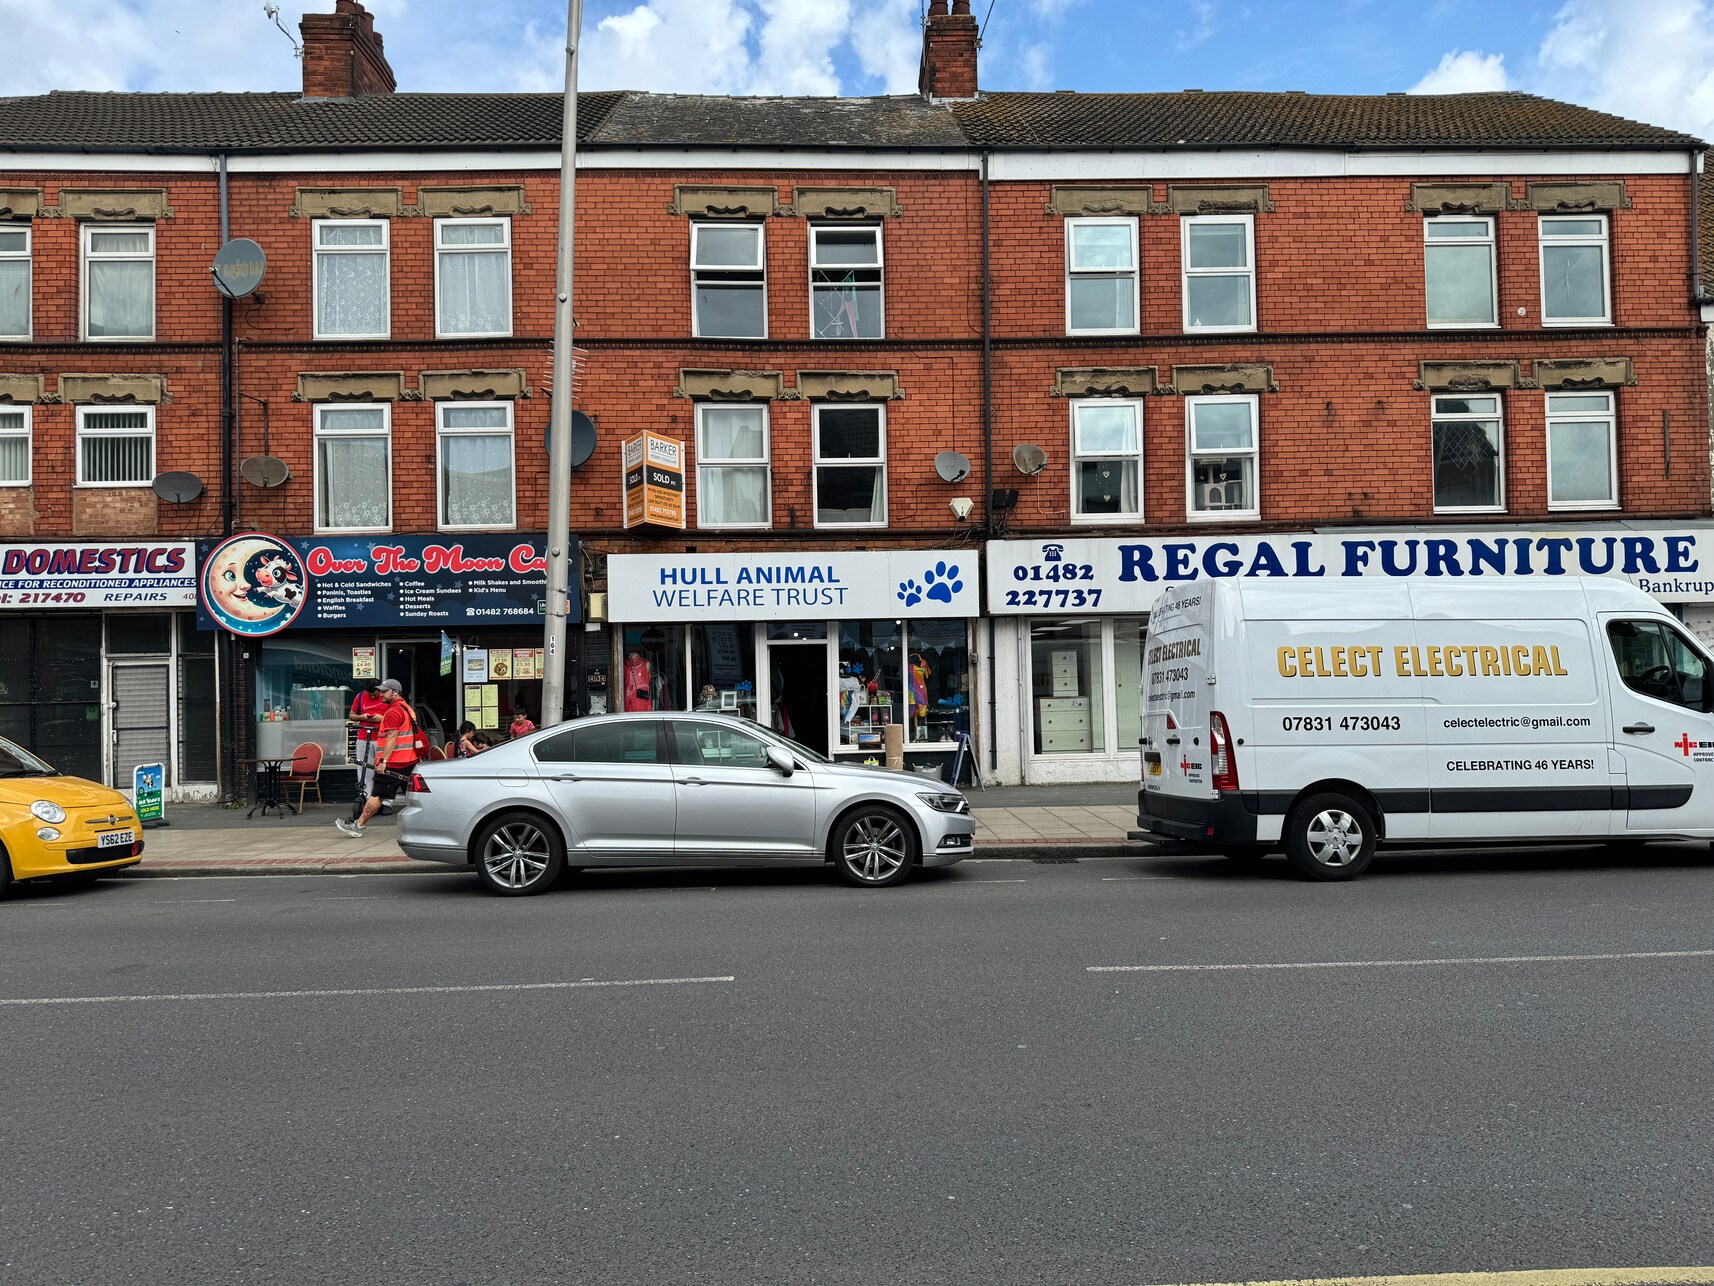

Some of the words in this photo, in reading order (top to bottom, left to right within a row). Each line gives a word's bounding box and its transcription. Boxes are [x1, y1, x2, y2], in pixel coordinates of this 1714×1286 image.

[650, 439, 677, 457] BARKER
[653, 472, 670, 484] SOLD
[2, 547, 186, 575] DOMESTICS
[307, 546, 367, 576] Over
[371, 545, 420, 575] The
[422, 544, 505, 573] Moon
[508, 544, 550, 576] Ca
[1118, 541, 1326, 582] REGAL
[1340, 535, 1700, 577] FURNITURE
[660, 567, 728, 585] HULL
[736, 565, 841, 584] ANIMAL
[1013, 563, 1095, 583] 01482
[18, 580, 40, 589] FOR
[43, 578, 129, 588] RECONDITIONED
[132, 578, 197, 587] APPLIANCES
[0, 592, 13, 604] l:
[18, 592, 86, 604] 217470
[104, 592, 168, 602] REPAIRS
[322, 597, 345, 605] English
[653, 588, 765, 607] WELFARE
[771, 587, 849, 606] TRUST
[1005, 588, 1102, 608] 227737
[1174, 600, 1181, 610] 46
[1181, 596, 1202, 609] YEARS!
[475, 608, 501, 616] 01482
[503, 607, 534, 615] 768684
[1162, 638, 1202, 662] ELECTRICAL
[1276, 646, 1383, 678] CELECT
[1393, 645, 1568, 678] ELECTRICAL
[1165, 667, 1189, 683] 473043
[1282, 716, 1332, 731] 07831
[1340, 715, 1401, 731] 473043
[1443, 716, 1591, 729] celectelectric@gmail.com
[1446, 759, 1532, 771] CELEBRATING
[1535, 759, 1548, 770] 46
[1551, 758, 1594, 770] YEARS!
[100, 833, 119, 846] YS62
[121, 831, 133, 843] EZE
